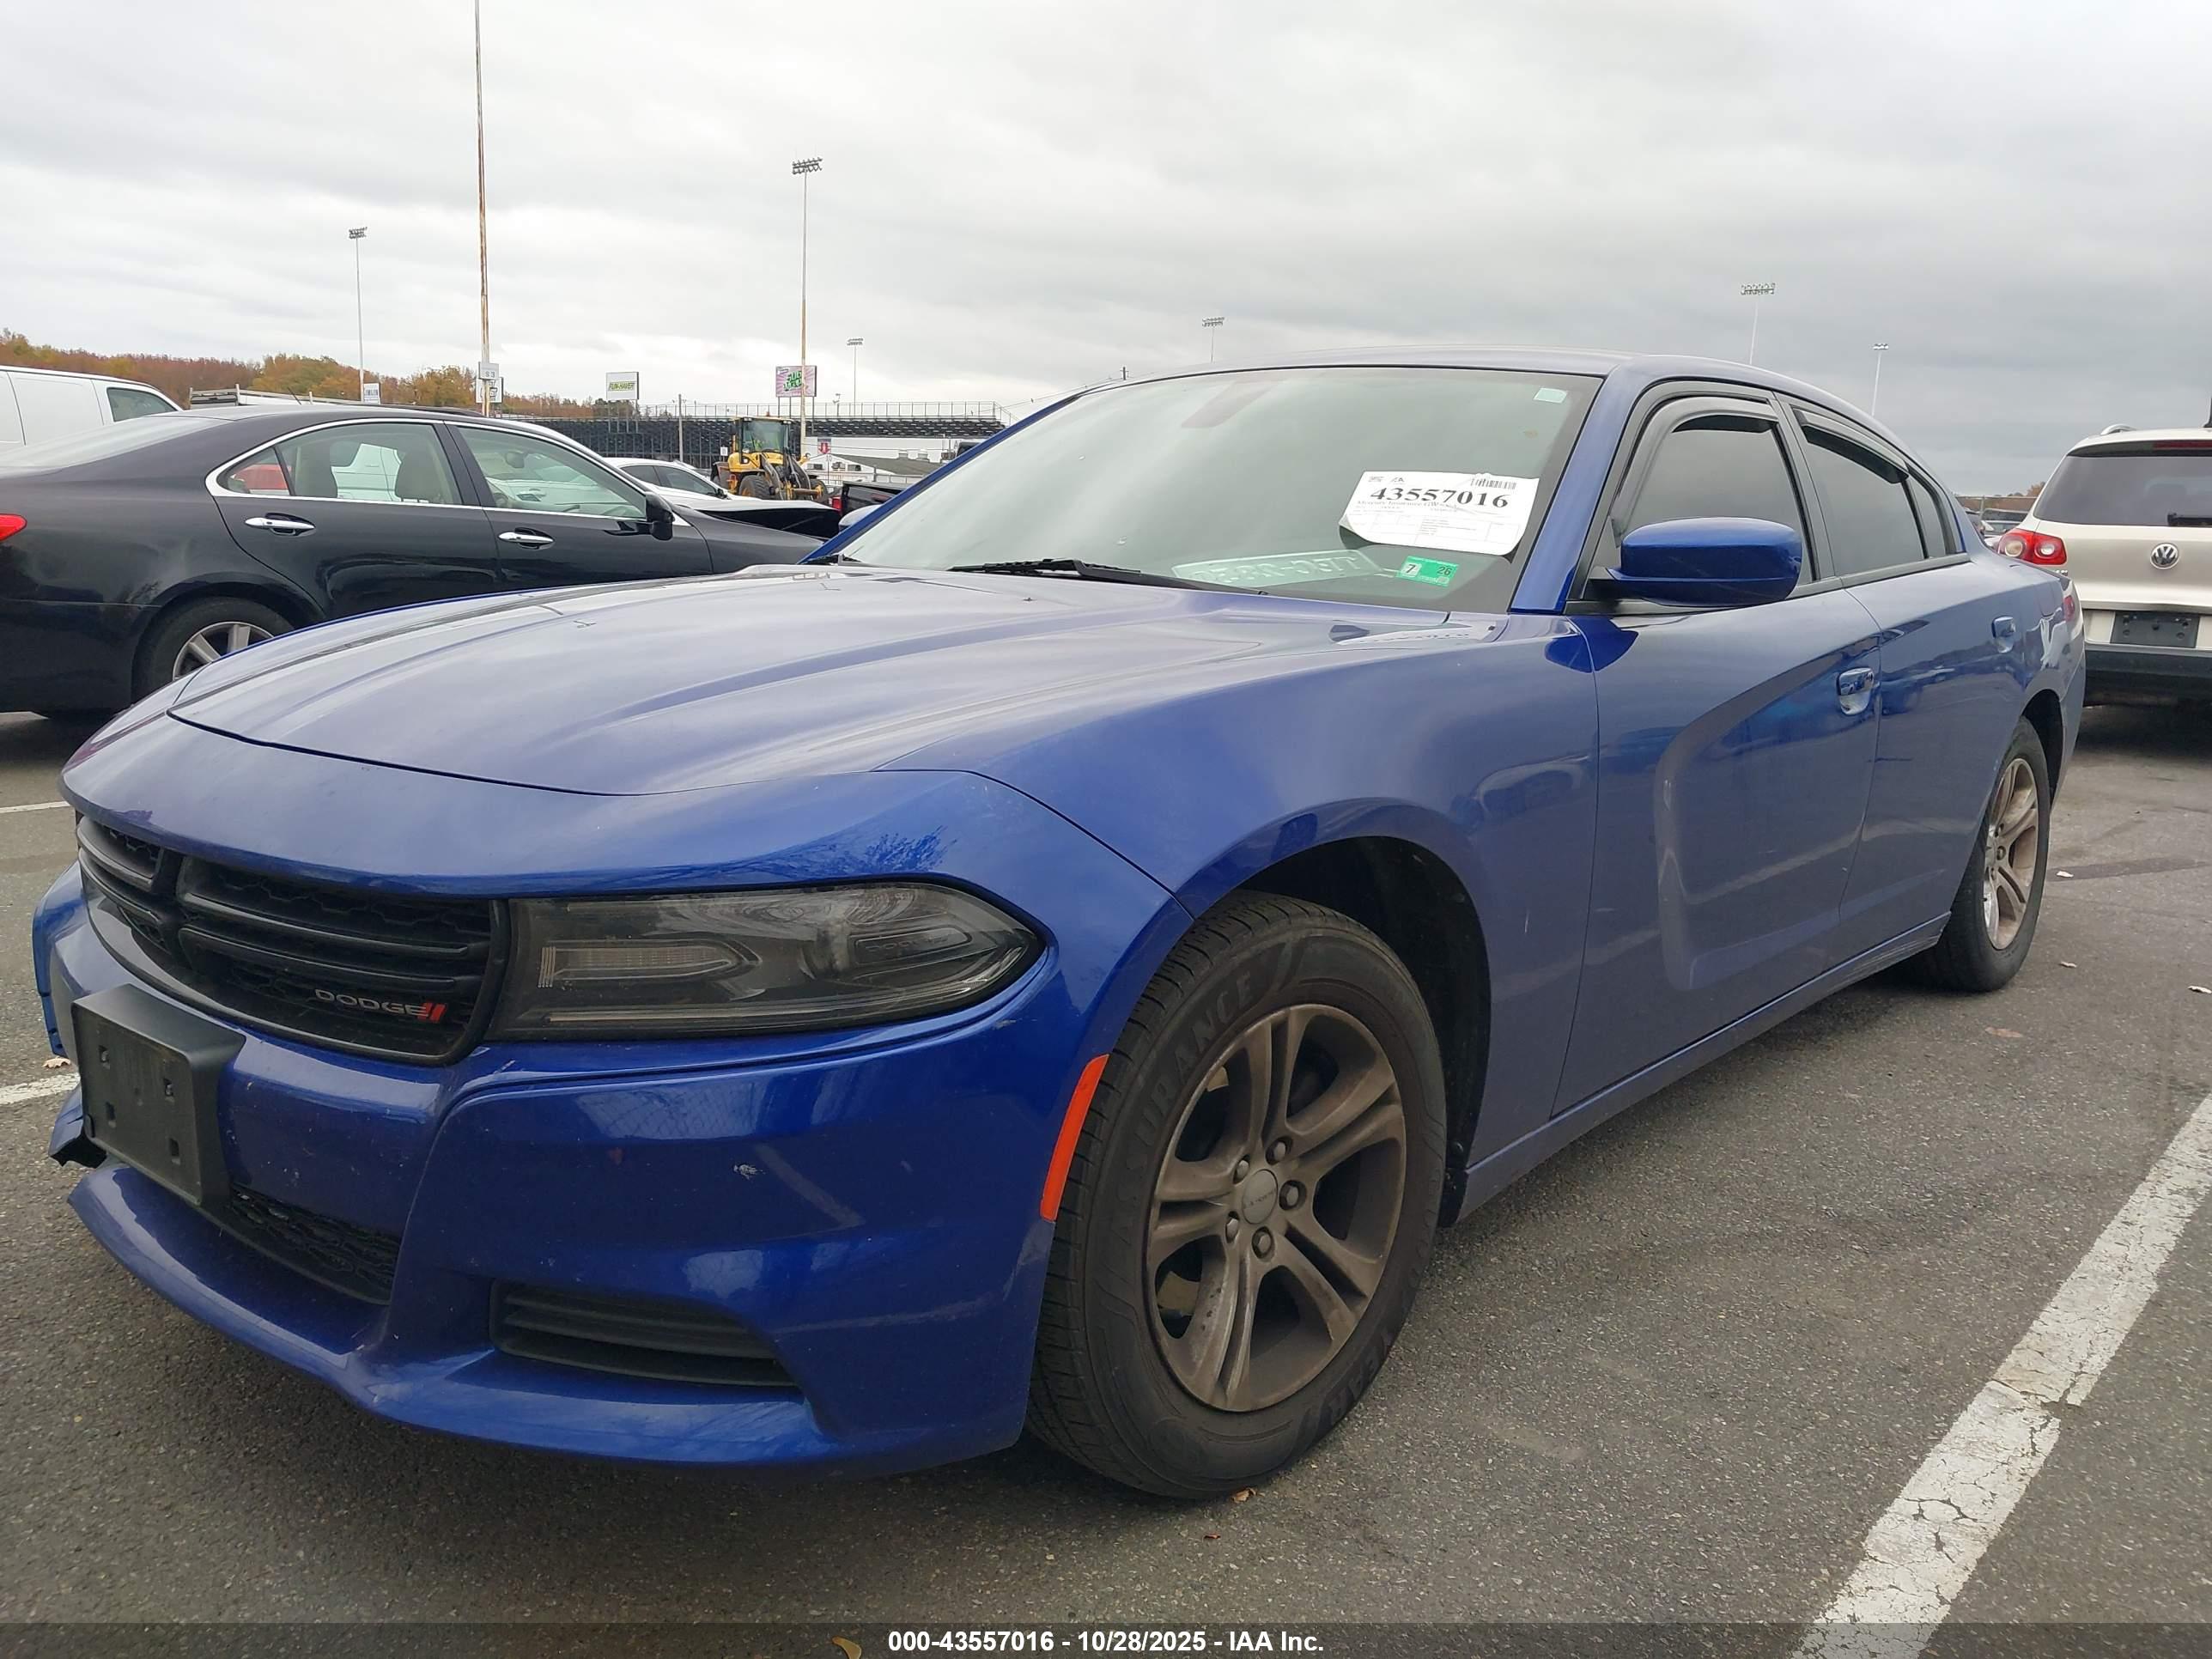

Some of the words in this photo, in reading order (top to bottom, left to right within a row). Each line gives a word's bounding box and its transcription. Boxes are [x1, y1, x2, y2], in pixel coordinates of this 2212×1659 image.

[1370, 487, 1511, 508] 43557016
[1406, 563, 1416, 574] 7
[1437, 566, 1452, 576] 26
[314, 988, 429, 1018] DODGE
[1114, 971, 1254, 1245] ASSURANCE
